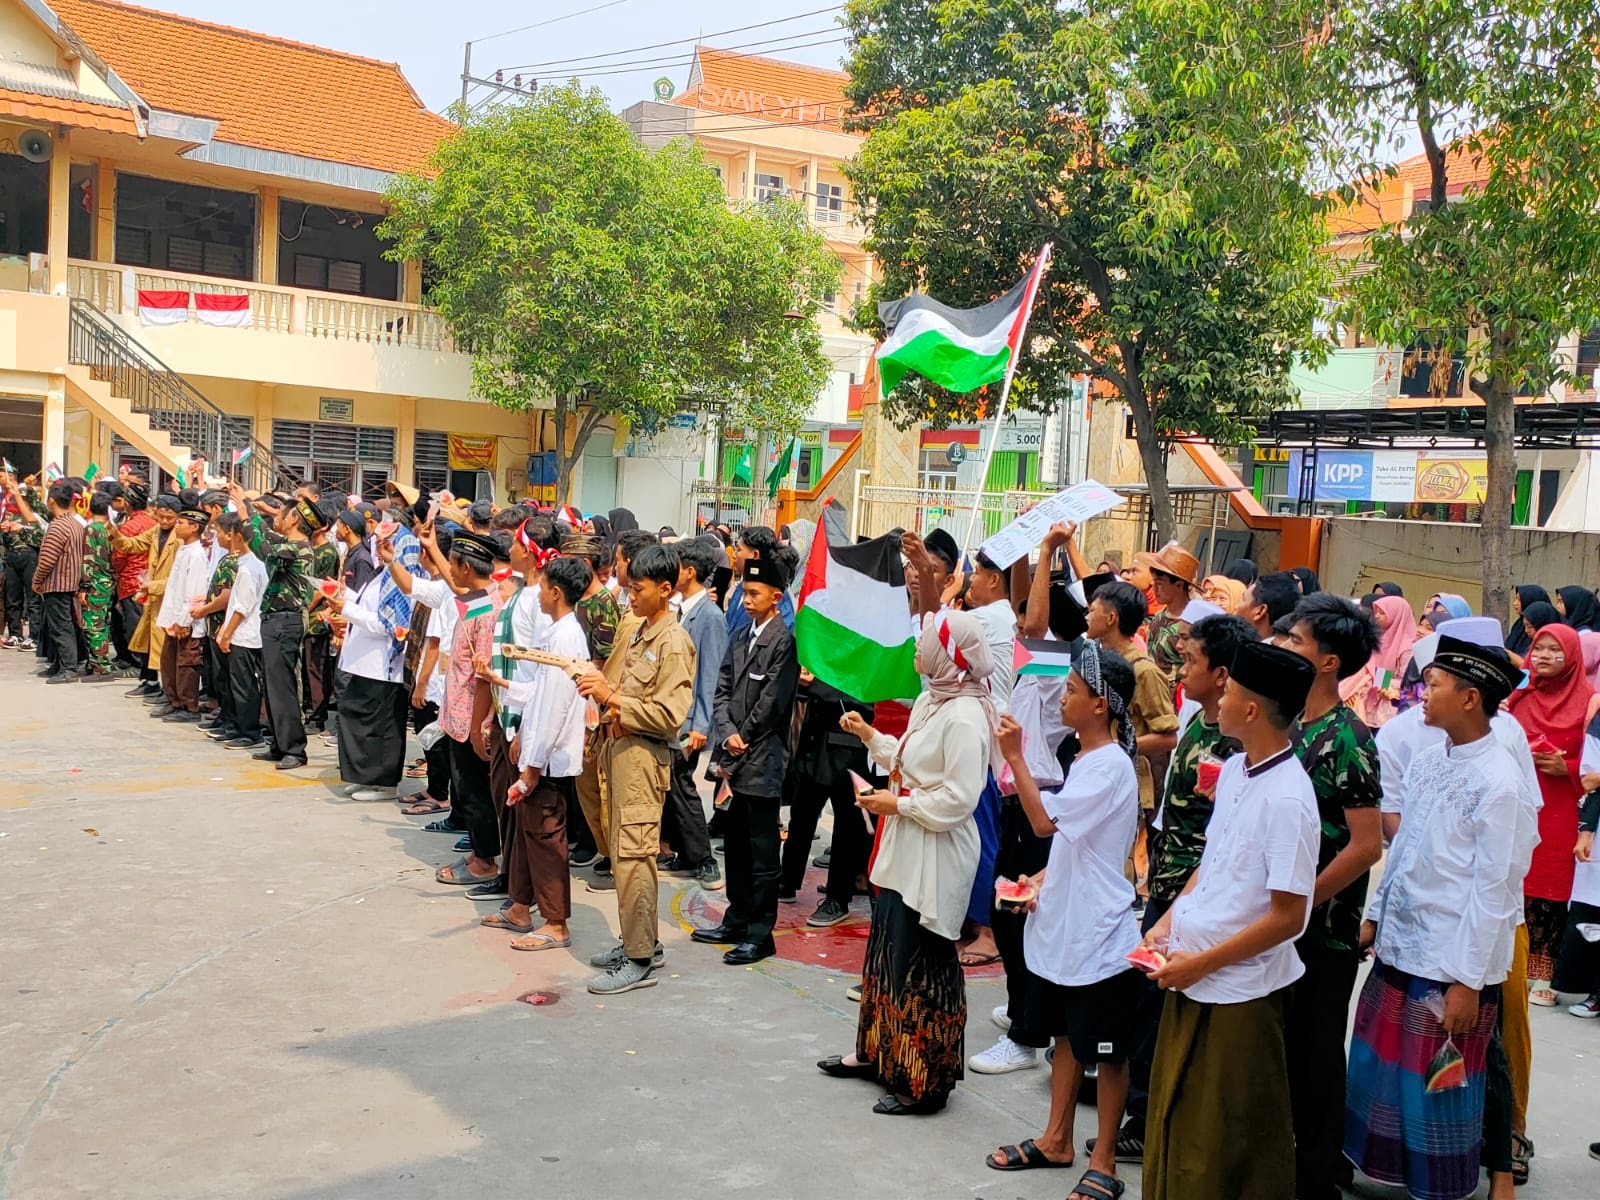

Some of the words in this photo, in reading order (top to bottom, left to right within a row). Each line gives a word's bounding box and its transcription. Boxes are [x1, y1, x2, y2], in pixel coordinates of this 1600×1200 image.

[805, 434, 819, 442] KOPI
[1324, 463, 1363, 483] KPP
[1428, 475, 1455, 488] JUARA
